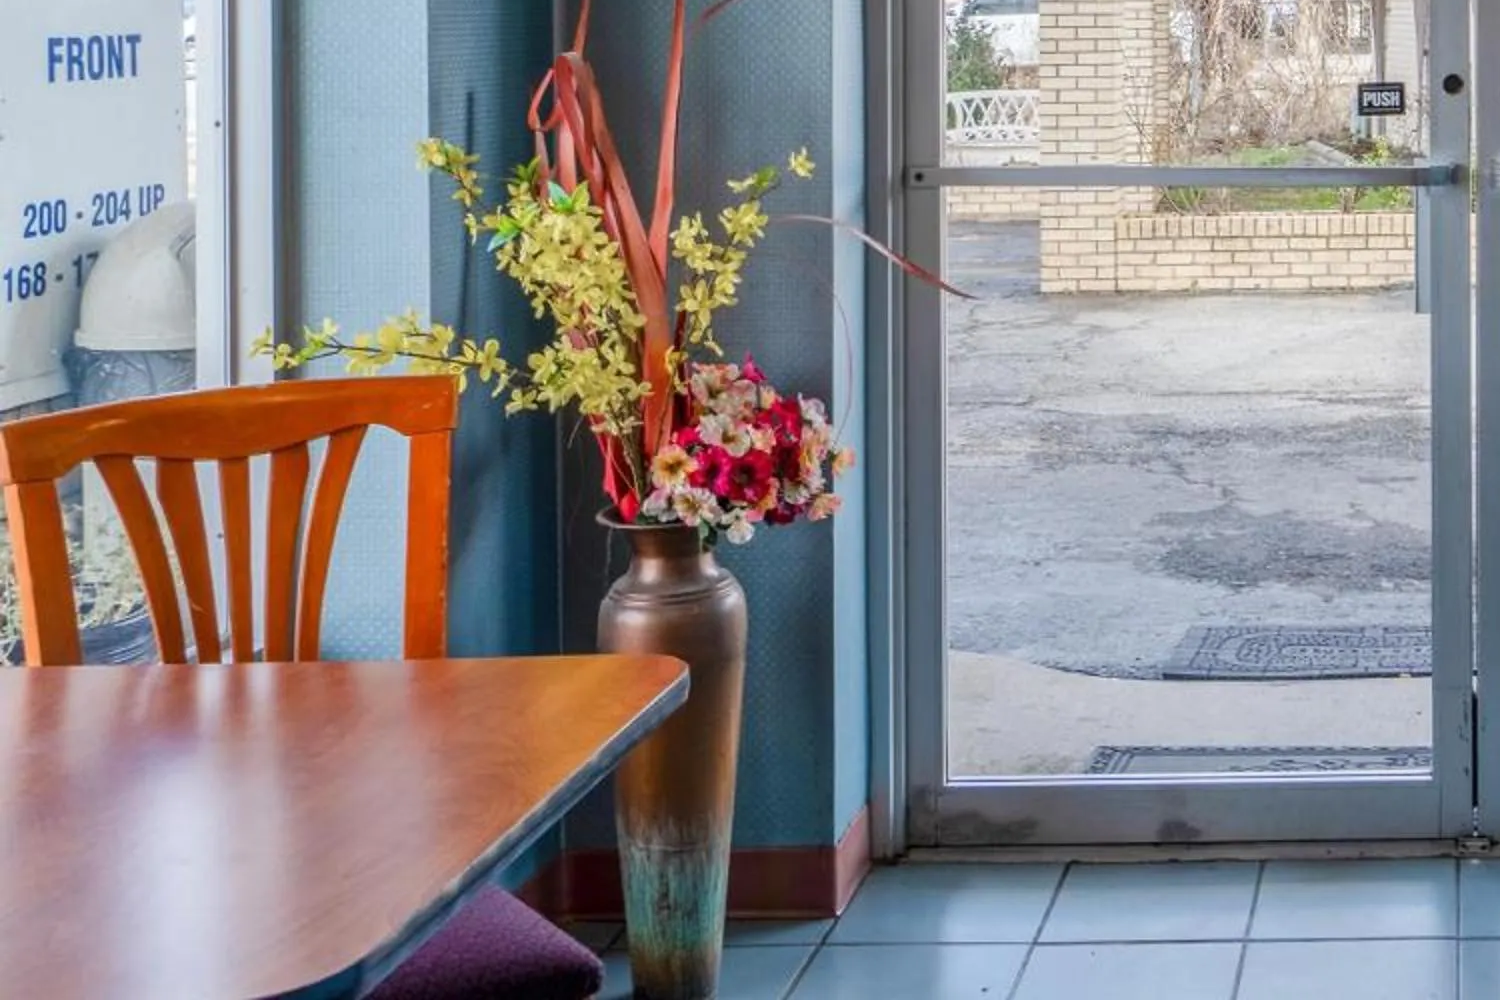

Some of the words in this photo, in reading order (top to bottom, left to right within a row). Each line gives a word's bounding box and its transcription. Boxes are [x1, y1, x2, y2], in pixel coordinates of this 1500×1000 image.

[47, 34, 142, 82] FRONT
[1363, 91, 1401, 107] PUSH
[23, 200, 67, 238] 200
[91, 188, 131, 227] 204
[138, 183, 165, 217] UP
[3, 261, 47, 302] 168
